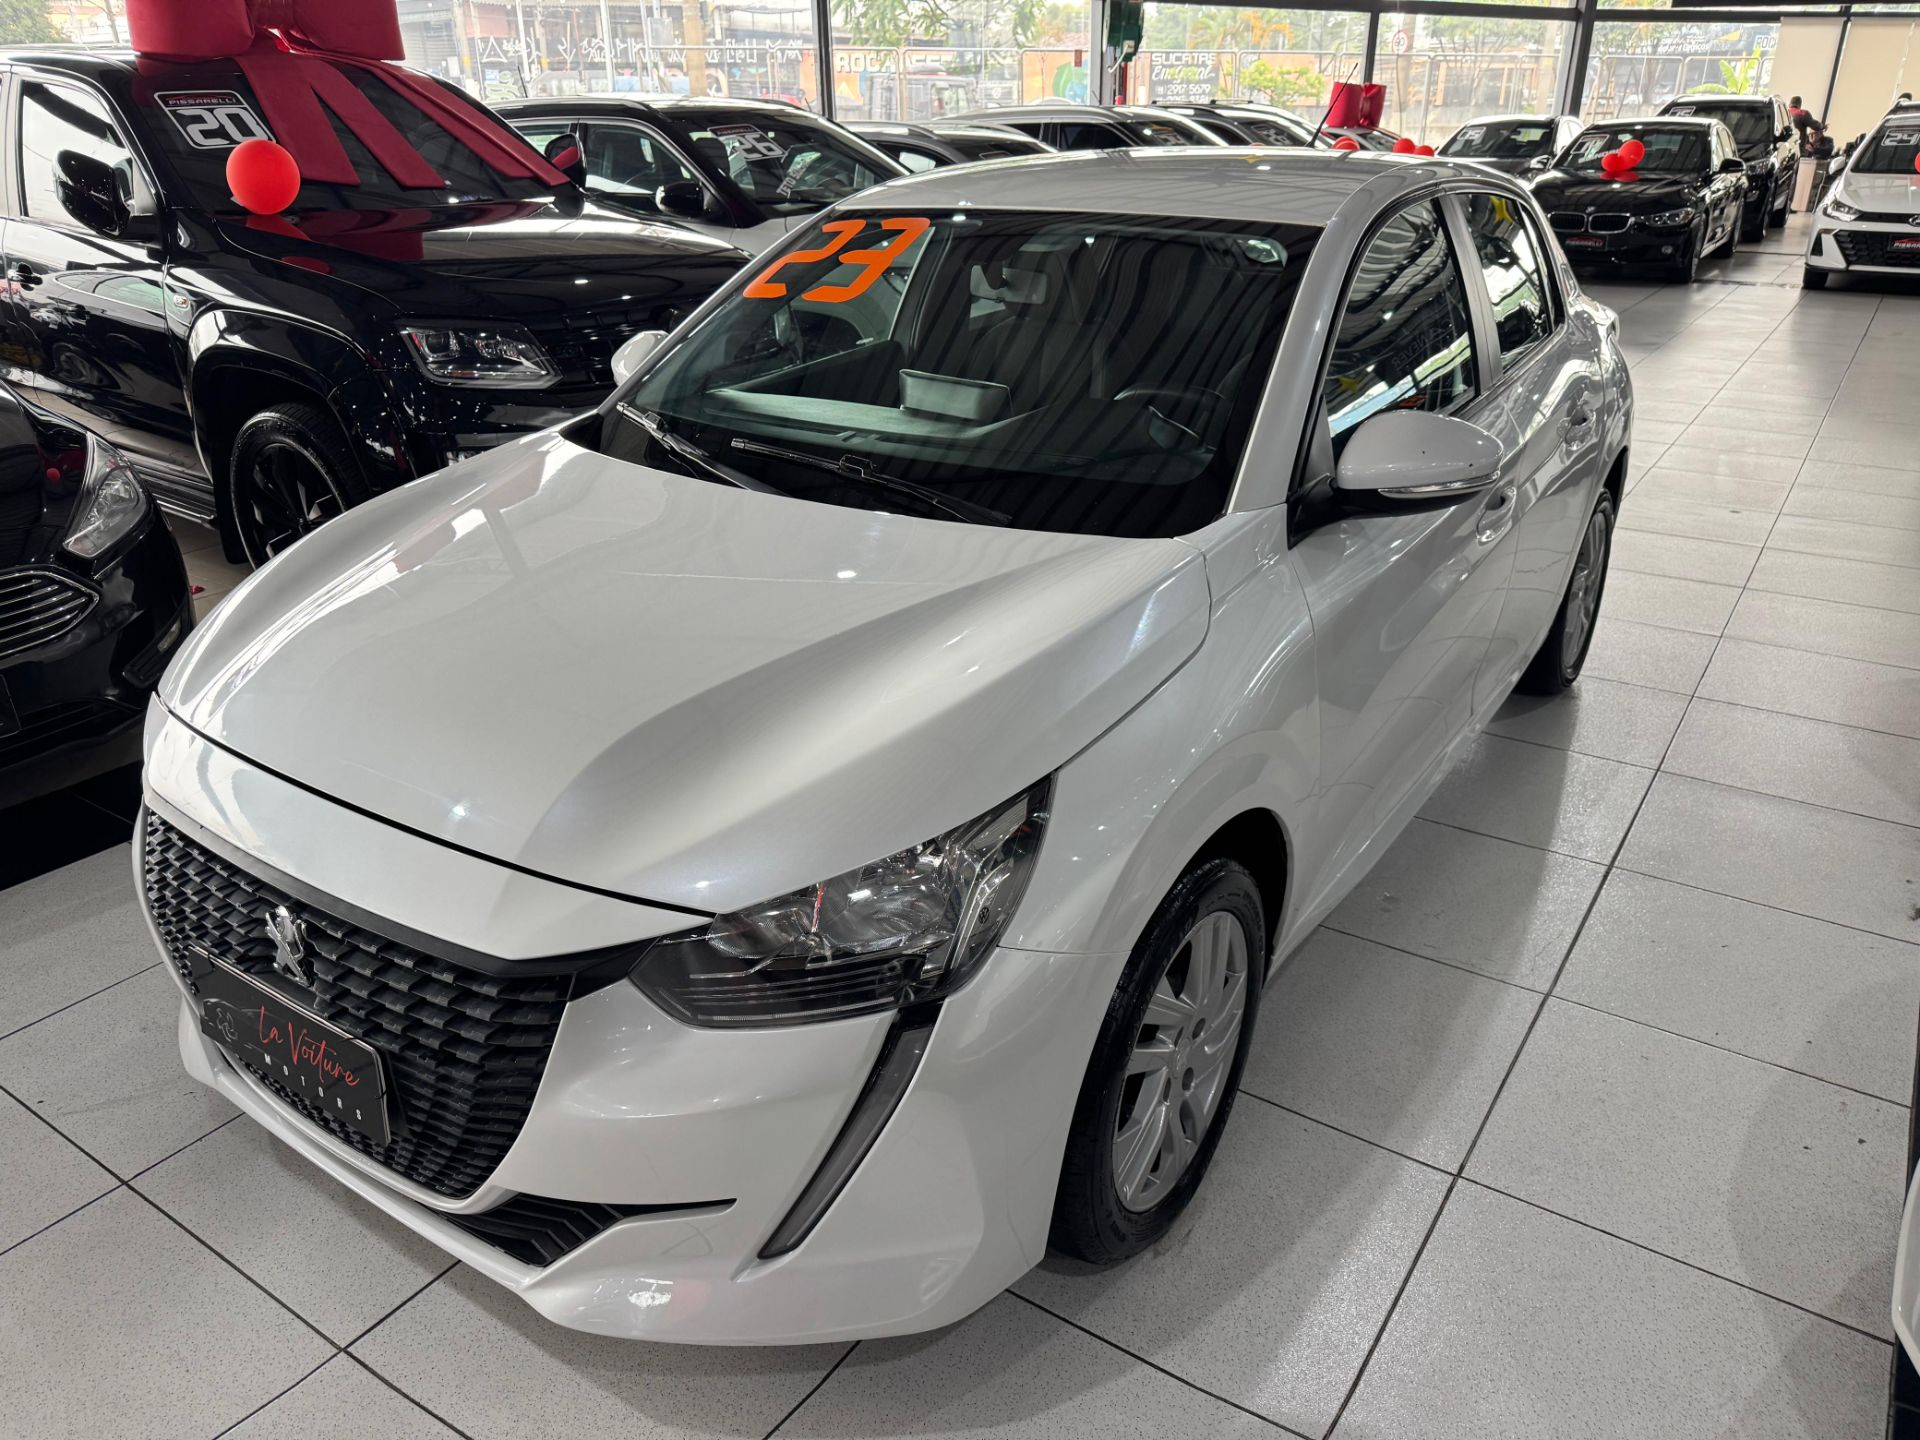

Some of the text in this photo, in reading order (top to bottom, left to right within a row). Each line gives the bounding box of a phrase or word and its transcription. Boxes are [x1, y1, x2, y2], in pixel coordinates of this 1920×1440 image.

[1152, 53, 1216, 65] SUCATAS
[1173, 65, 1216, 83] gal
[175, 107, 269, 146] 20
[1884, 133, 1918, 146] 24
[743, 217, 931, 303] 23
[288, 1021, 360, 1087] Voiture
